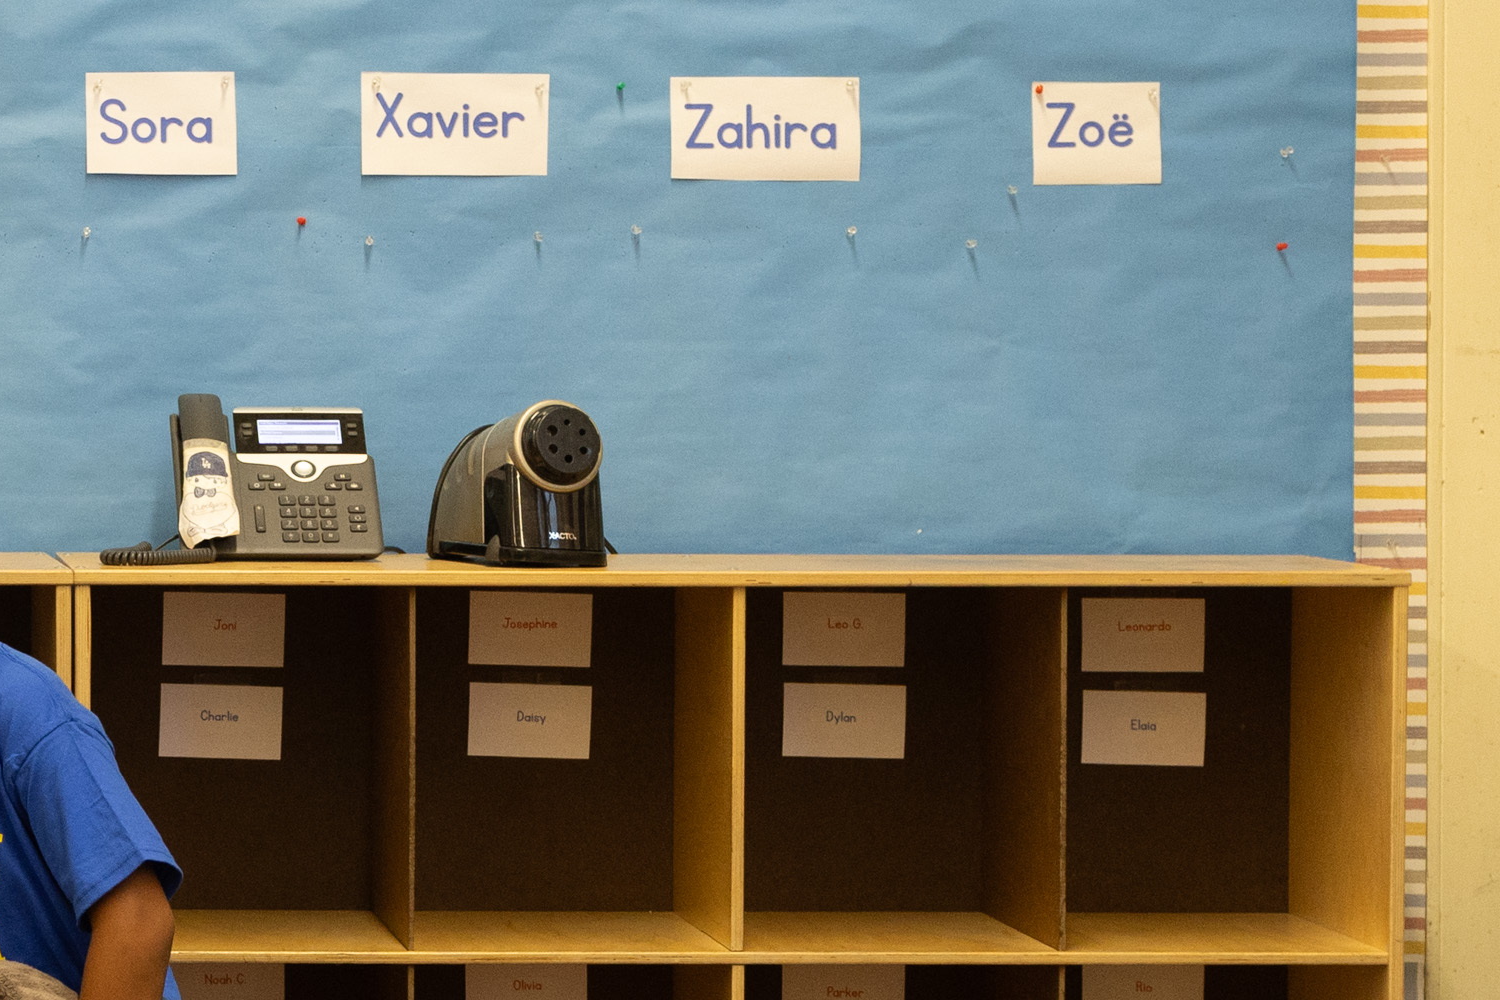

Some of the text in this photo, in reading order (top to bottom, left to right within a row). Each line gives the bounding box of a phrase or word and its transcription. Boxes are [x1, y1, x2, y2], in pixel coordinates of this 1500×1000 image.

[99, 98, 214, 145] Sora
[376, 92, 526, 138] Xavier
[684, 103, 838, 149] Zahira
[1046, 102, 1134, 148] Zoë
[502, 617, 558, 631] Josephine
[827, 617, 849, 629] Leo
[1117, 620, 1172, 632] Leonardo
[200, 708, 239, 722] Charlie
[516, 709, 547, 725] Daisy
[825, 710, 857, 725] Dylan
[204, 973, 233, 985] Noah
[512, 979, 543, 991] Olivia
[826, 985, 864, 998] Parker
